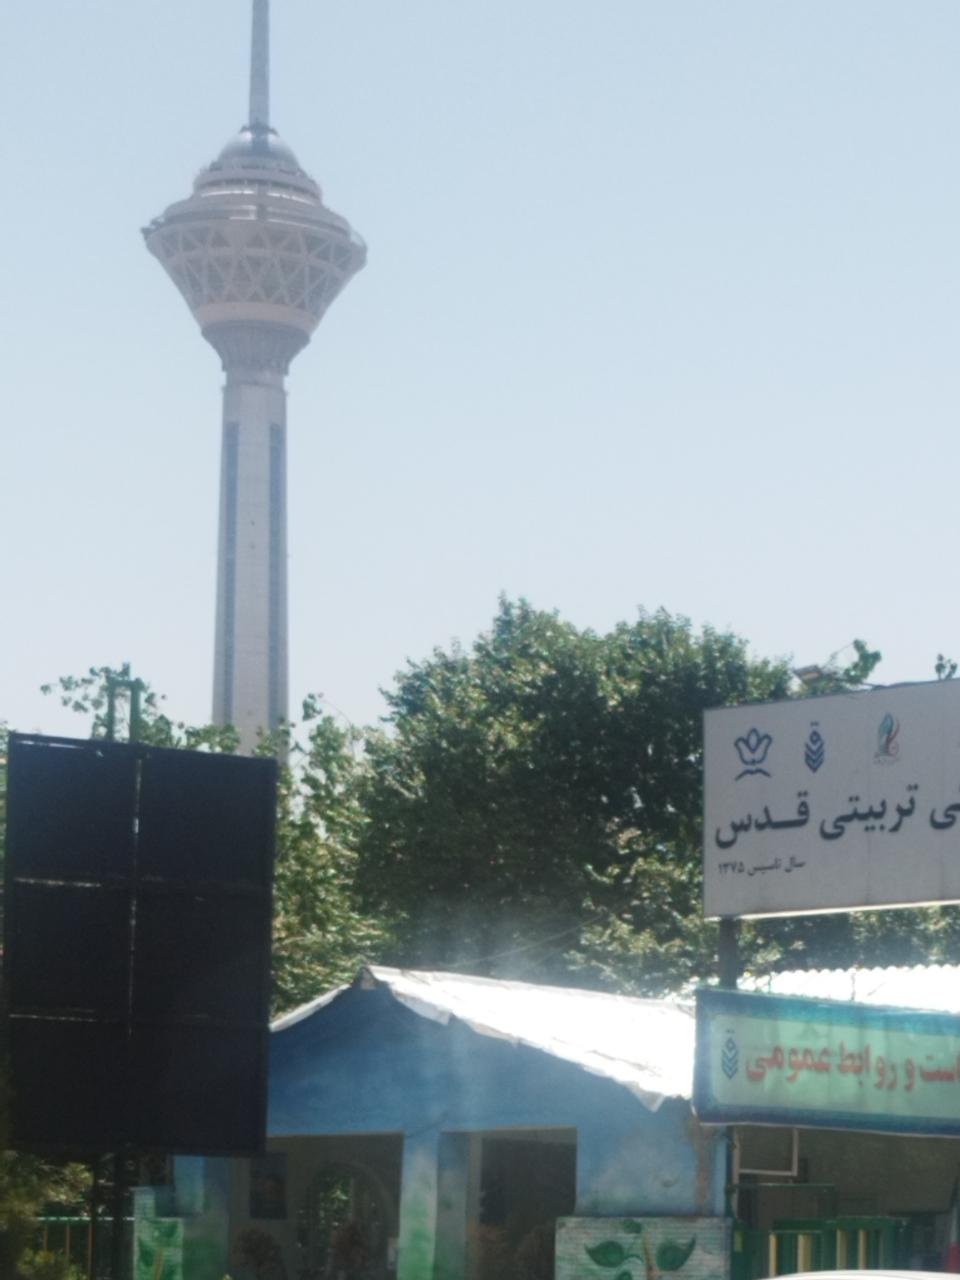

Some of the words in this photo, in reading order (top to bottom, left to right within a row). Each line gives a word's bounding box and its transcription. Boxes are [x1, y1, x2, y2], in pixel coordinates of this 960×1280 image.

[715, 790, 810, 849] قدس
[819, 784, 919, 841] تربیتی
[746, 1043, 832, 1083] عمومی
[838, 1041, 898, 1090] روابط
[905, 1055, 916, 1092] و
